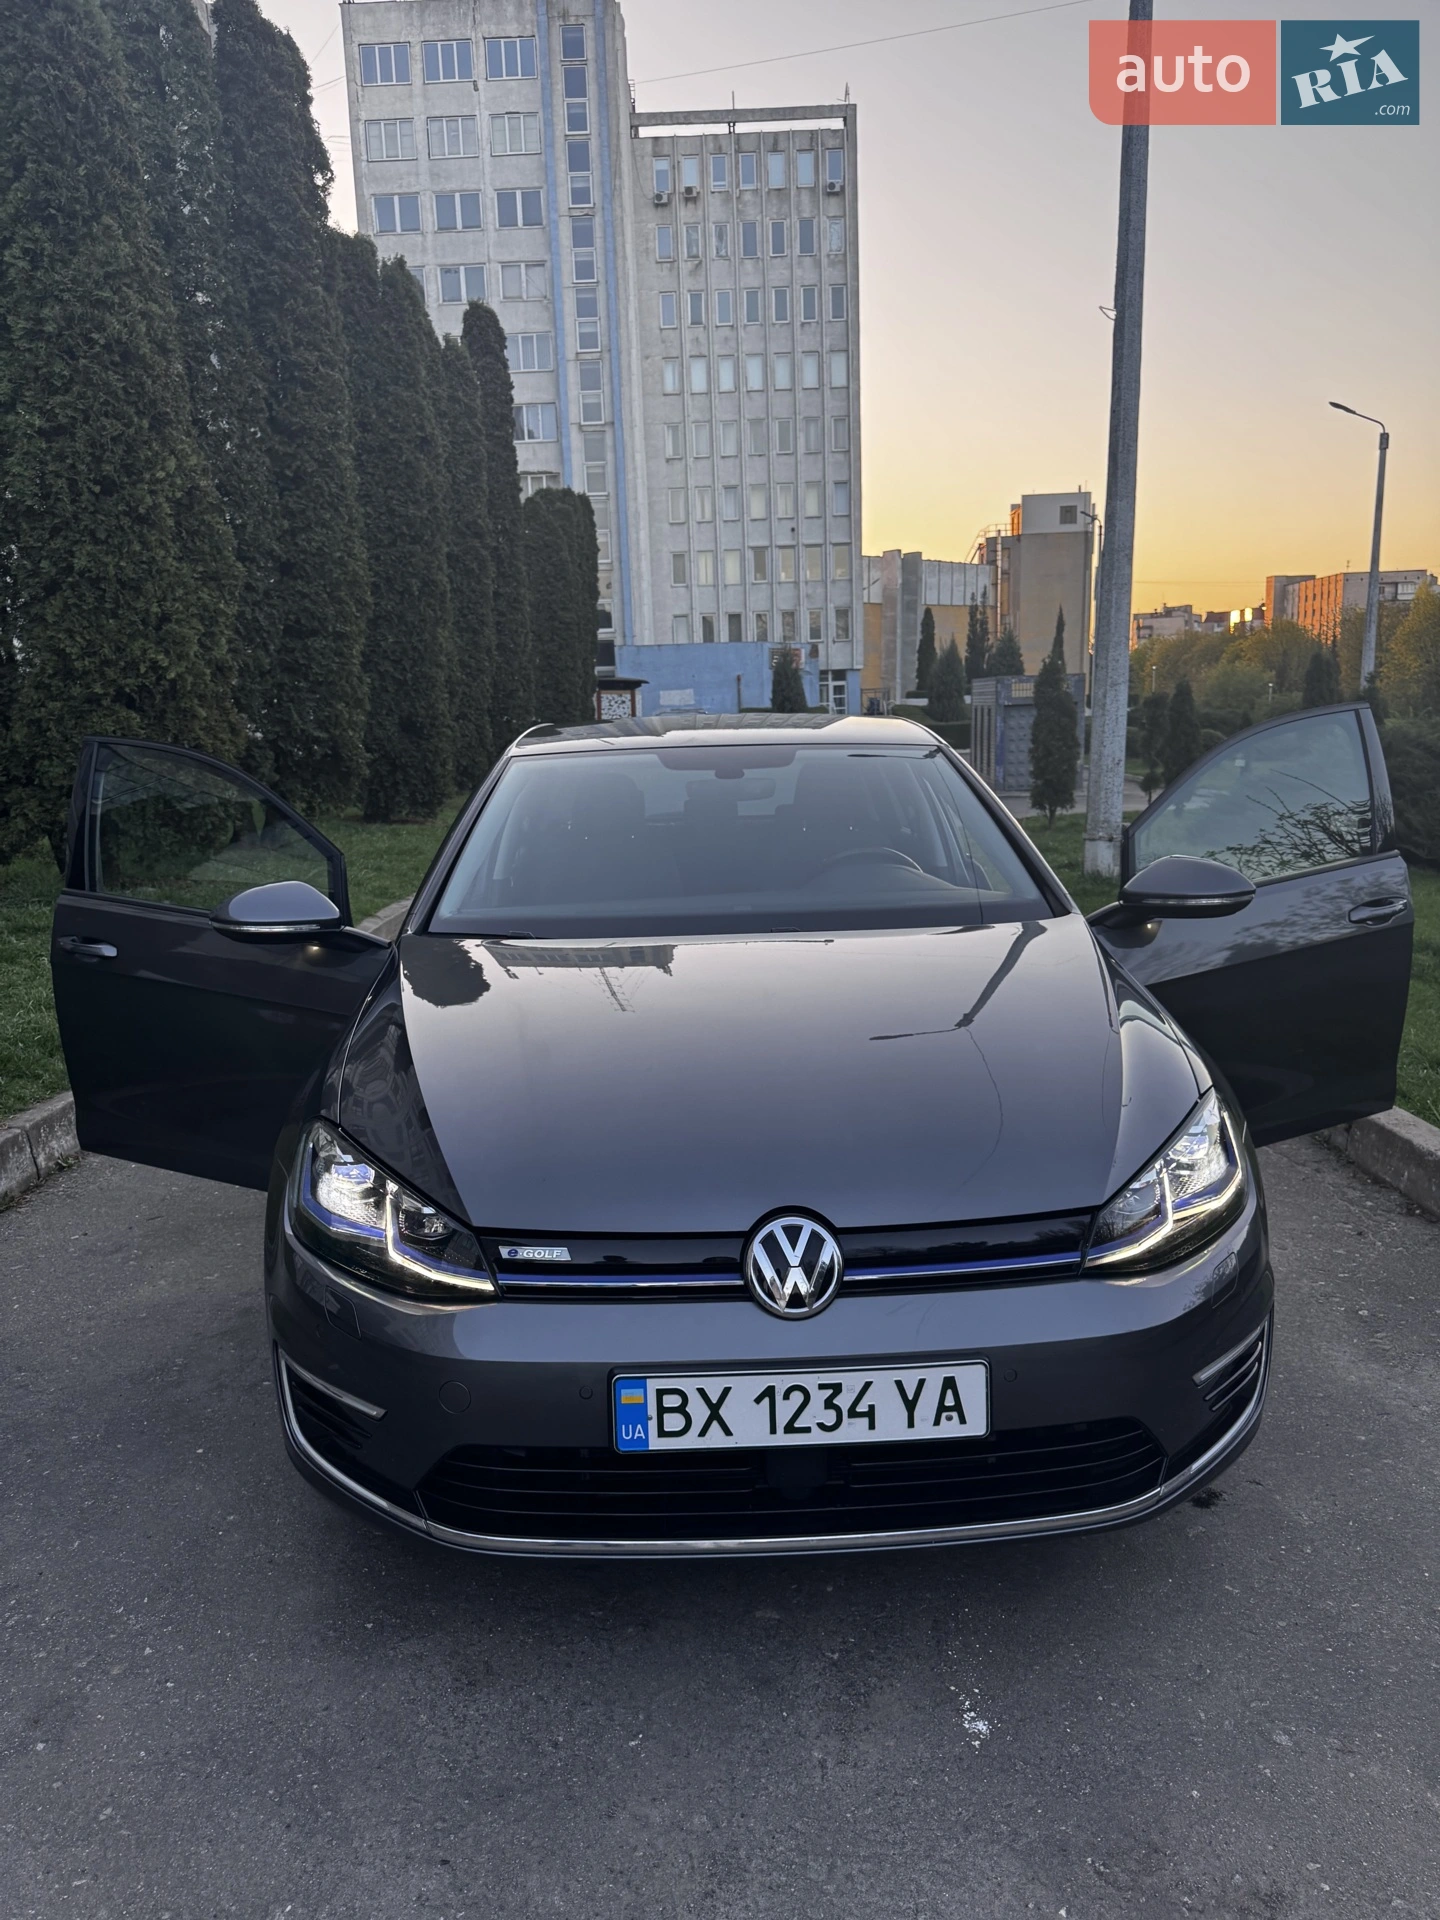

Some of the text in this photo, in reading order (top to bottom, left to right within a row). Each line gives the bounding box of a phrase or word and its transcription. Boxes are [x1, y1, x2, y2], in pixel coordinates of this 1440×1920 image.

[752, 1216, 838, 1313] VW
[621, 1423, 646, 1440] UA
[655, 1374, 968, 1439] BX 1234 YA
